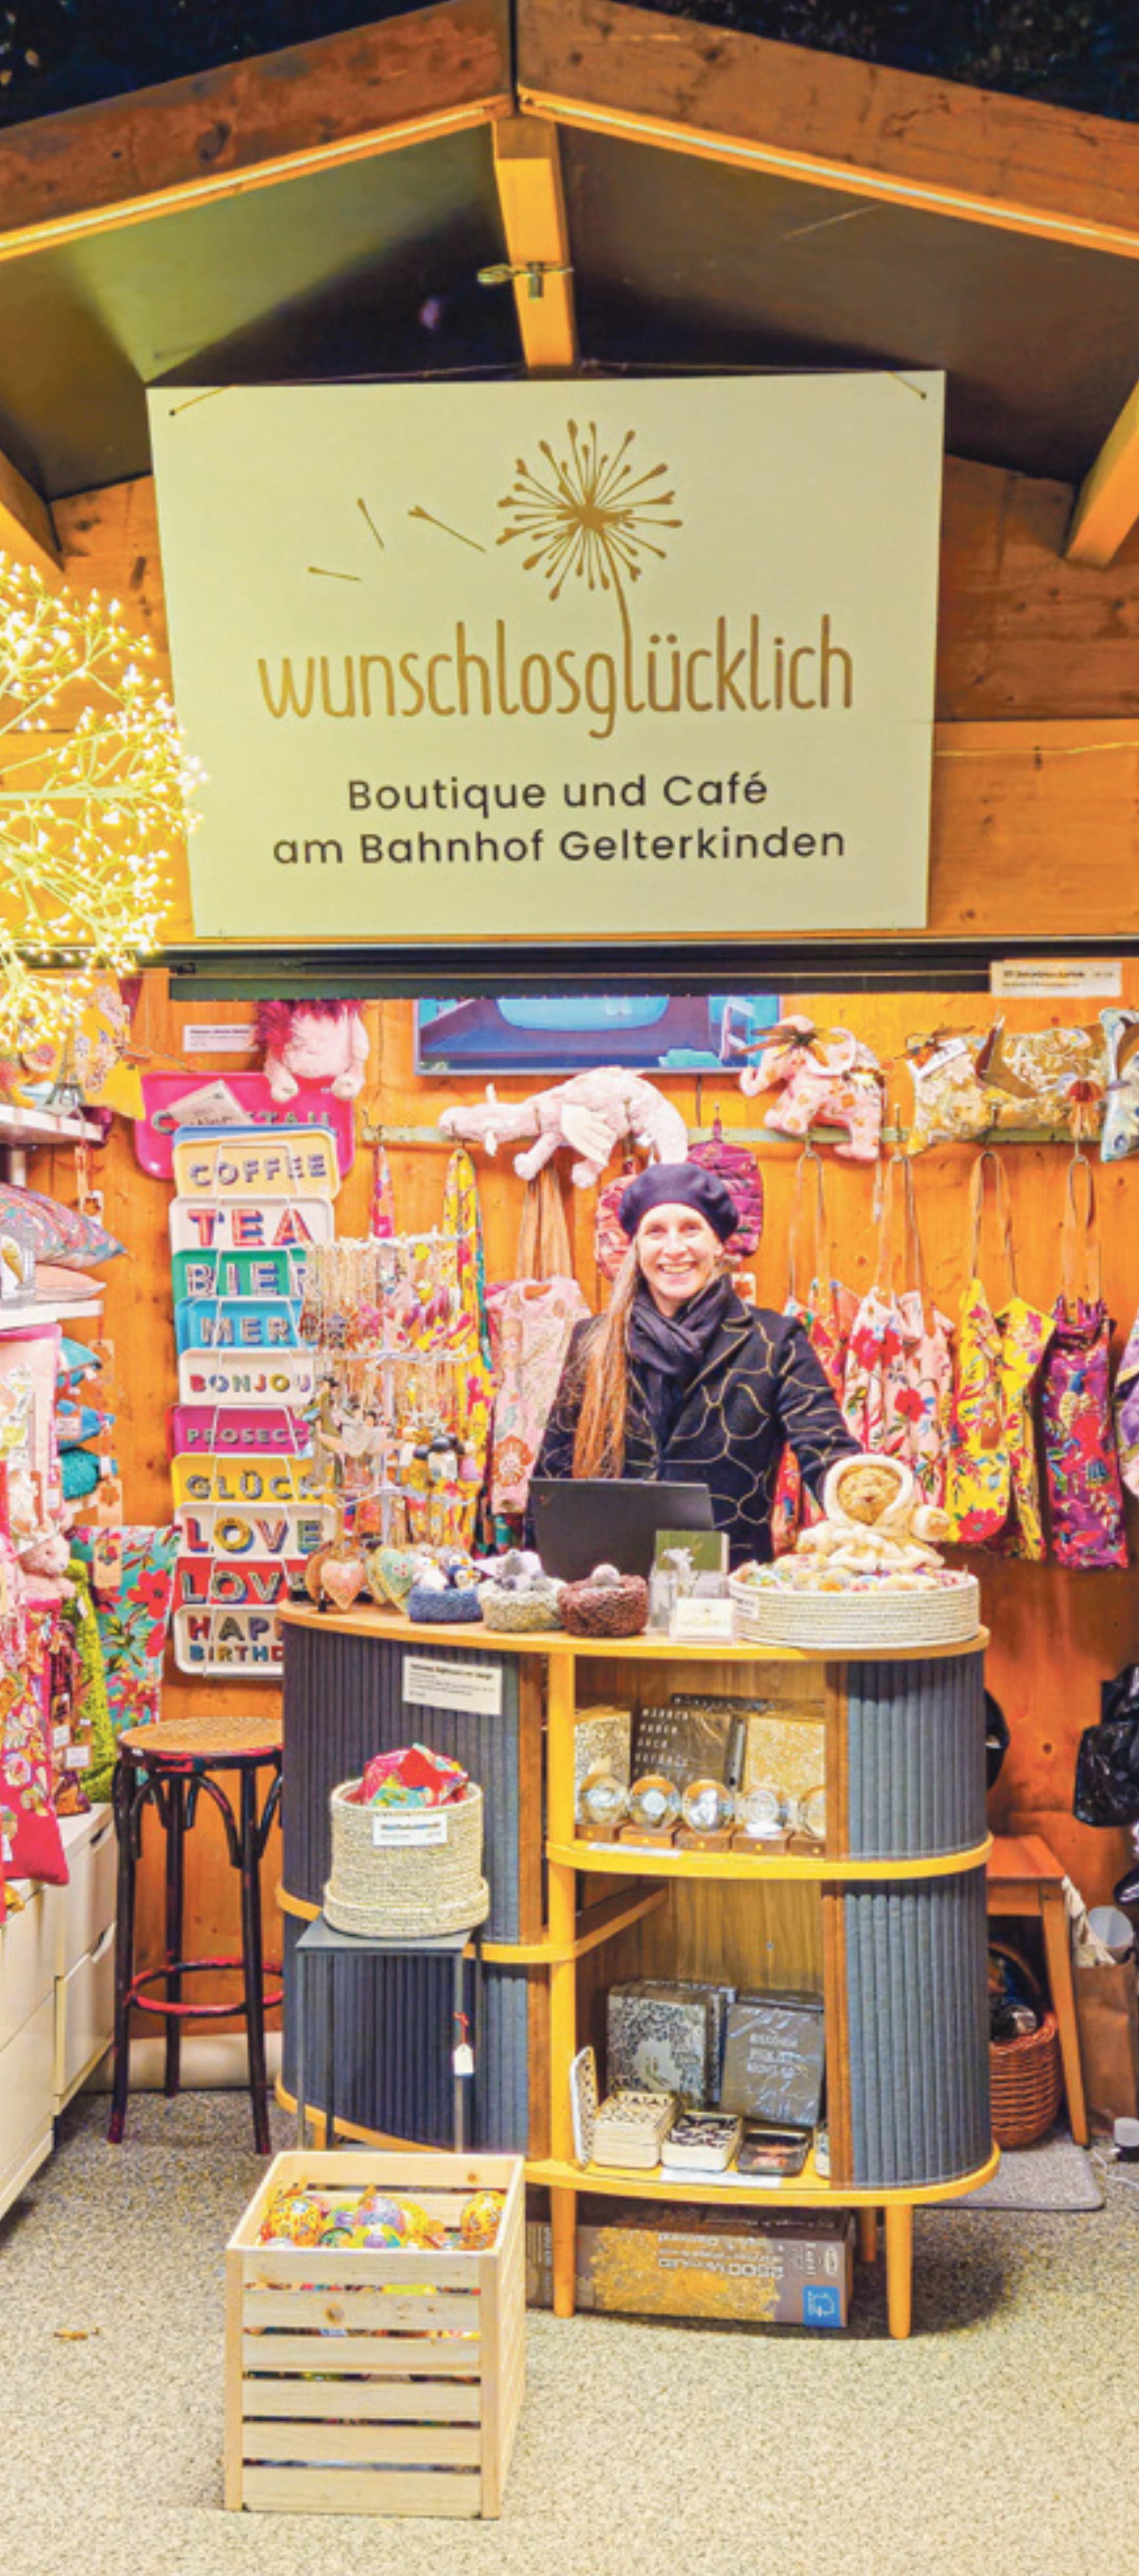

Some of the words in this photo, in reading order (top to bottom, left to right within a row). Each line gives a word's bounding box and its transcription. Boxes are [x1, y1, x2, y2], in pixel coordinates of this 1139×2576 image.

[259, 613, 853, 740] wunschlosglücklich
[348, 775, 546, 819] Boutique
[563, 774, 646, 808] und
[663, 771, 768, 806] Café
[273, 839, 343, 864] am
[359, 828, 544, 864] Bahnhof
[559, 826, 844, 861] Gelterkinden
[190, 1154, 327, 1187] COFFEE
[187, 1209, 313, 1246] TEA
[201, 1317, 319, 1346] MER
[189, 1373, 311, 1393] BONJOU
[187, 1428, 314, 1445] PROSECC
[186, 1517, 324, 1553] LOVE
[187, 1615, 283, 1642] HAP
[189, 1645, 284, 1662] BIRTHD
